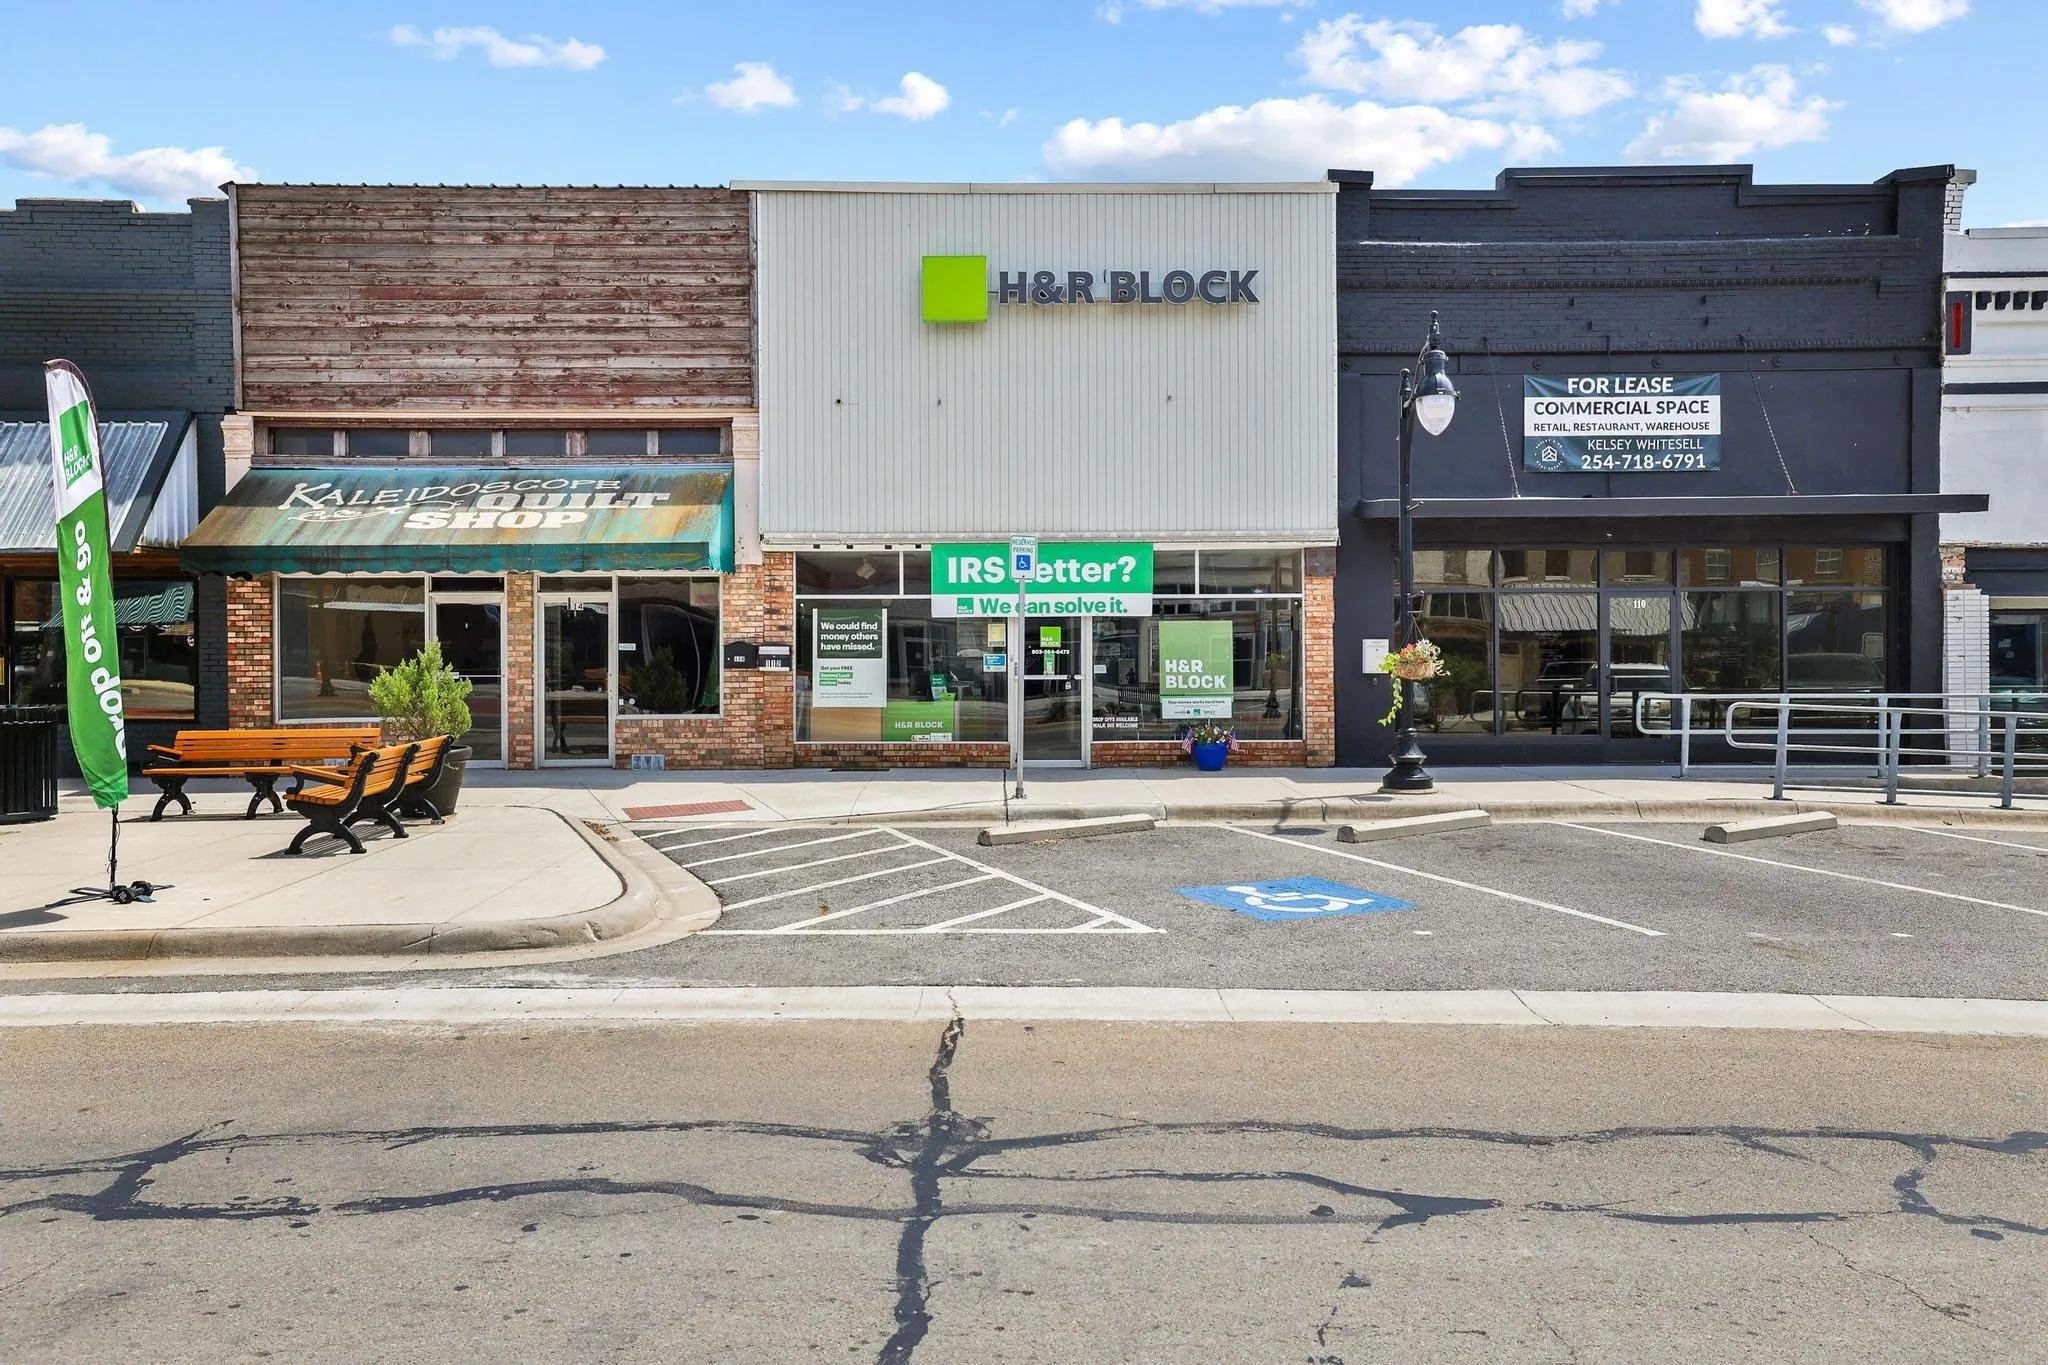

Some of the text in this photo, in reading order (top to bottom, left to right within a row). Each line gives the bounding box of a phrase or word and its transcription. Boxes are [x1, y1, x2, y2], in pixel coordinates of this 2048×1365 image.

[1000, 268, 1262, 304] H&R BLOCK
[1567, 376, 1674, 394] FOR LEASE
[1533, 400, 1710, 415] COMMERCIAL SPACE
[1533, 421, 1710, 433] RETAIL, RESTAURANT, WAREHOUSE
[1587, 438, 1704, 451] KELSEY WHITESELL
[1580, 453, 1707, 470] 254-718-6791
[277, 478, 621, 510] KALEIDOSCOPE
[476, 491, 671, 510] QUILT
[403, 510, 589, 530] SHOP
[74, 519, 92, 571] go
[948, 555, 1137, 584] IRS etter?
[76, 572, 92, 606] &
[978, 597, 1012, 614] We
[1054, 596, 1106, 614] solve
[1110, 596, 1128, 614] it.
[1633, 599, 1647, 609] 110
[820, 622, 878, 630] We could find
[80, 612, 102, 663] off
[820, 632, 879, 641] money others
[820, 642, 876, 651] have missed.
[1165, 659, 1203, 673] H&R
[1165, 675, 1227, 689] BLOCK
[895, 721, 944, 729] H&R BLOCK
